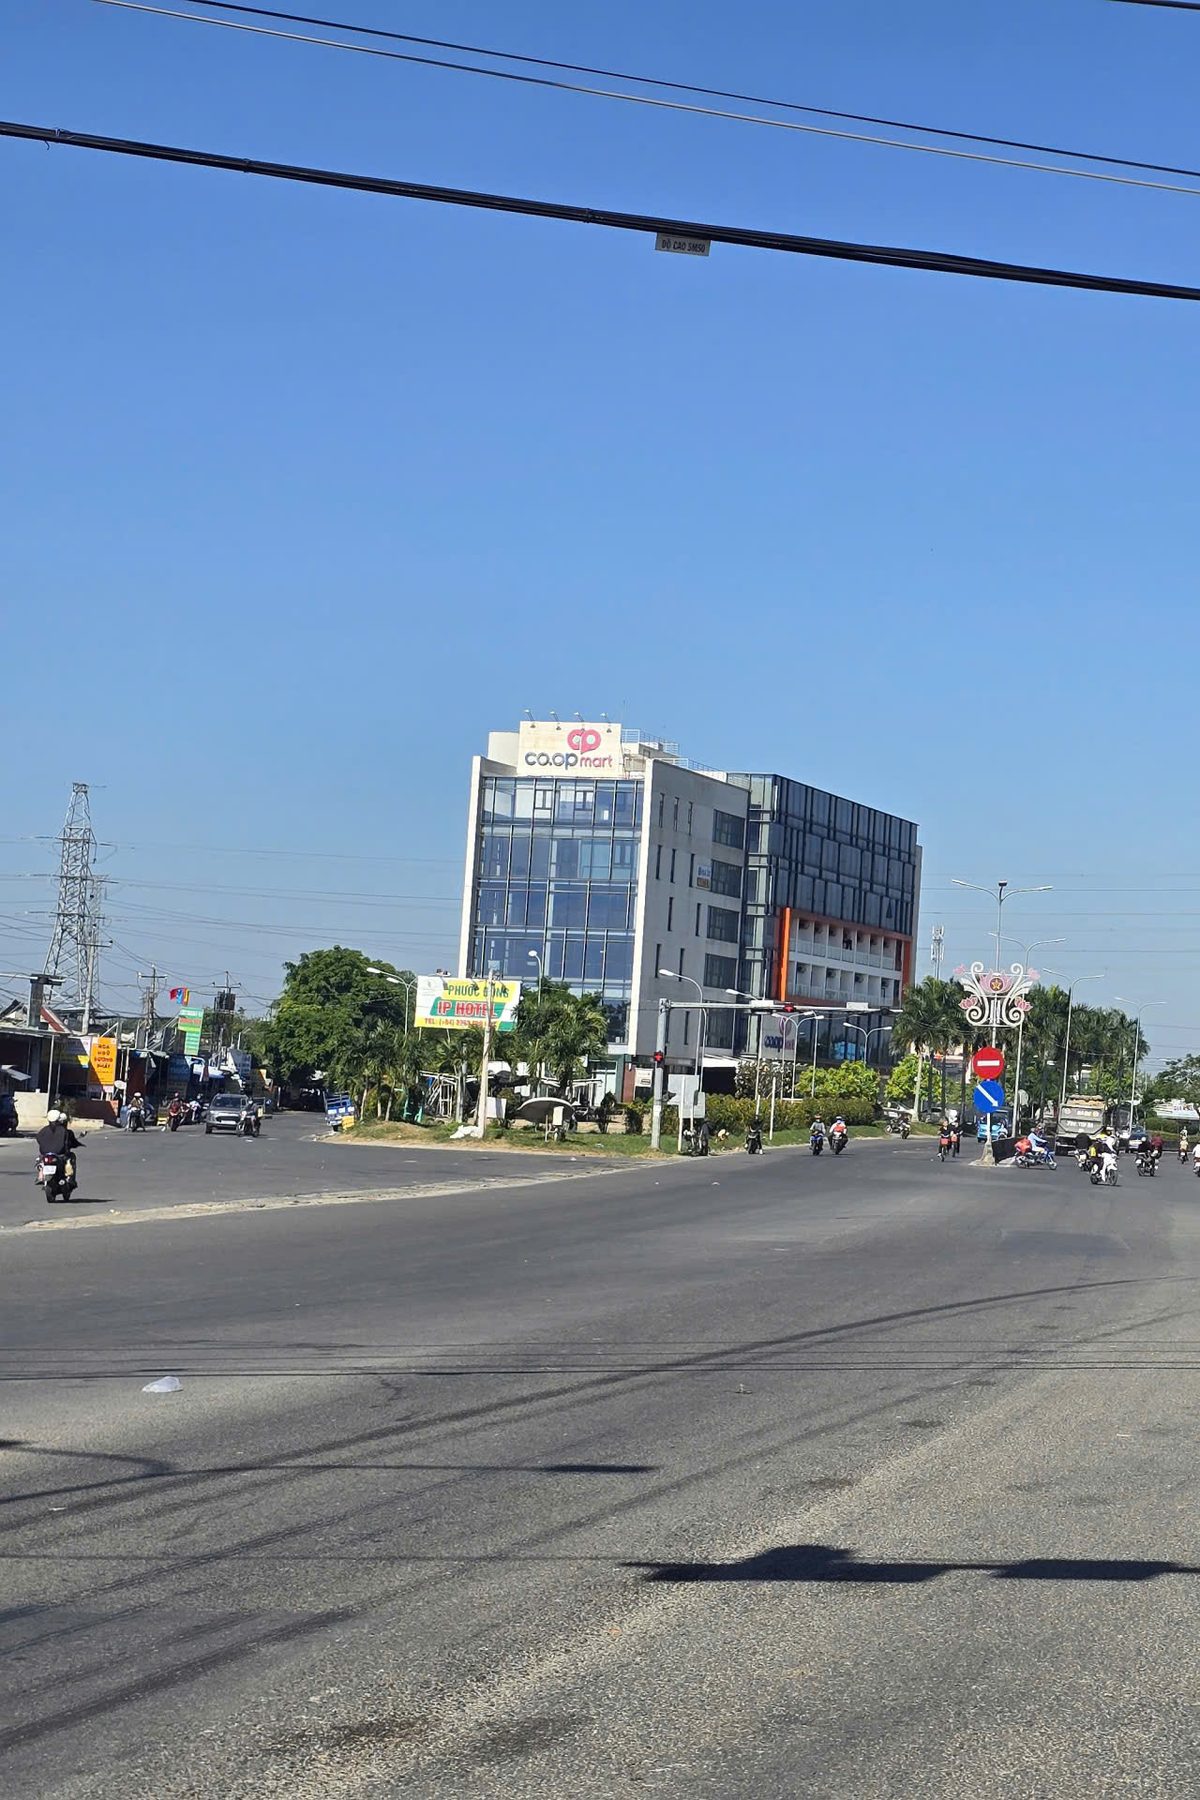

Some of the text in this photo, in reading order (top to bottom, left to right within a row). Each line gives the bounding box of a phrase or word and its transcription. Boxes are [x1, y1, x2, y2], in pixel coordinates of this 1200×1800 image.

[672, 240, 686, 251] CAO
[438, 1001, 497, 1017] IP HOTEL
